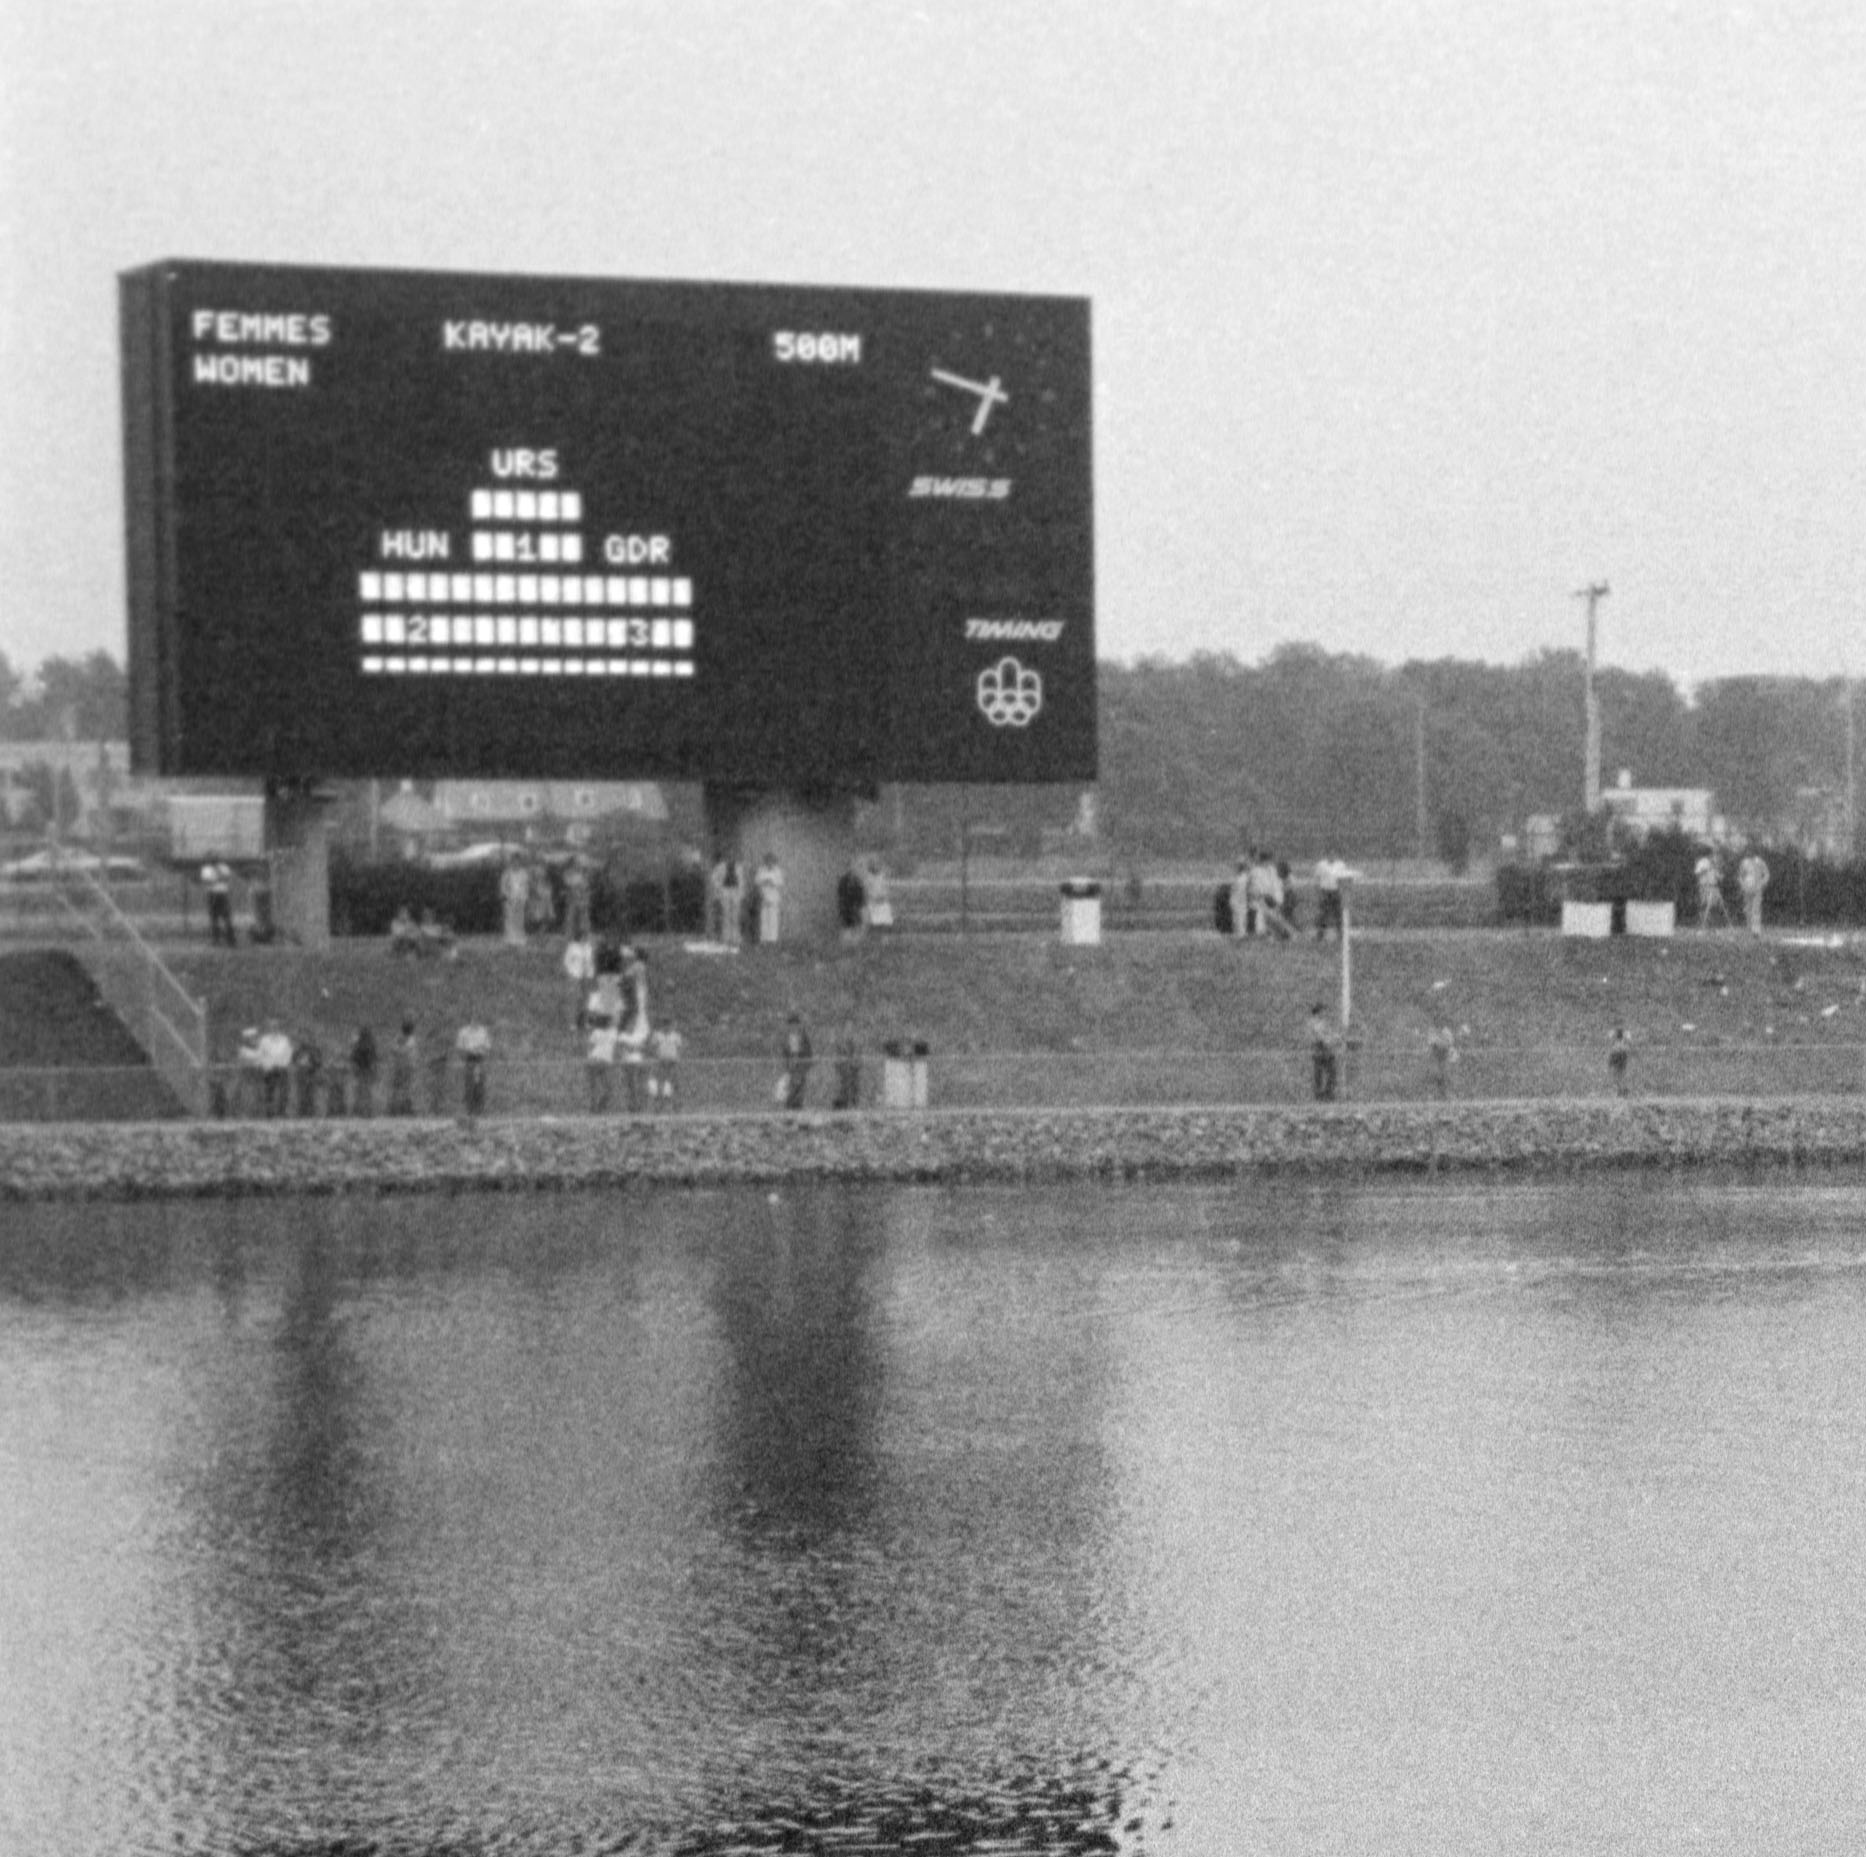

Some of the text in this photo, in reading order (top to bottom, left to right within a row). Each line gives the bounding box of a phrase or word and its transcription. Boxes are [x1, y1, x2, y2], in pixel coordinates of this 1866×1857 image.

[192, 310, 331, 345] FEMMES
[443, 319, 601, 355] KAYAK-2
[773, 331, 861, 363] 500M
[194, 354, 310, 386] WOMEN
[491, 449, 558, 479] URS
[908, 476, 1011, 498] SWISS
[381, 531, 449, 559] HUN
[517, 532, 537, 561] 1
[604, 534, 670, 564] GDR
[406, 616, 428, 643] 2
[628, 618, 650, 647] 3
[964, 618, 1065, 641] TIMING
